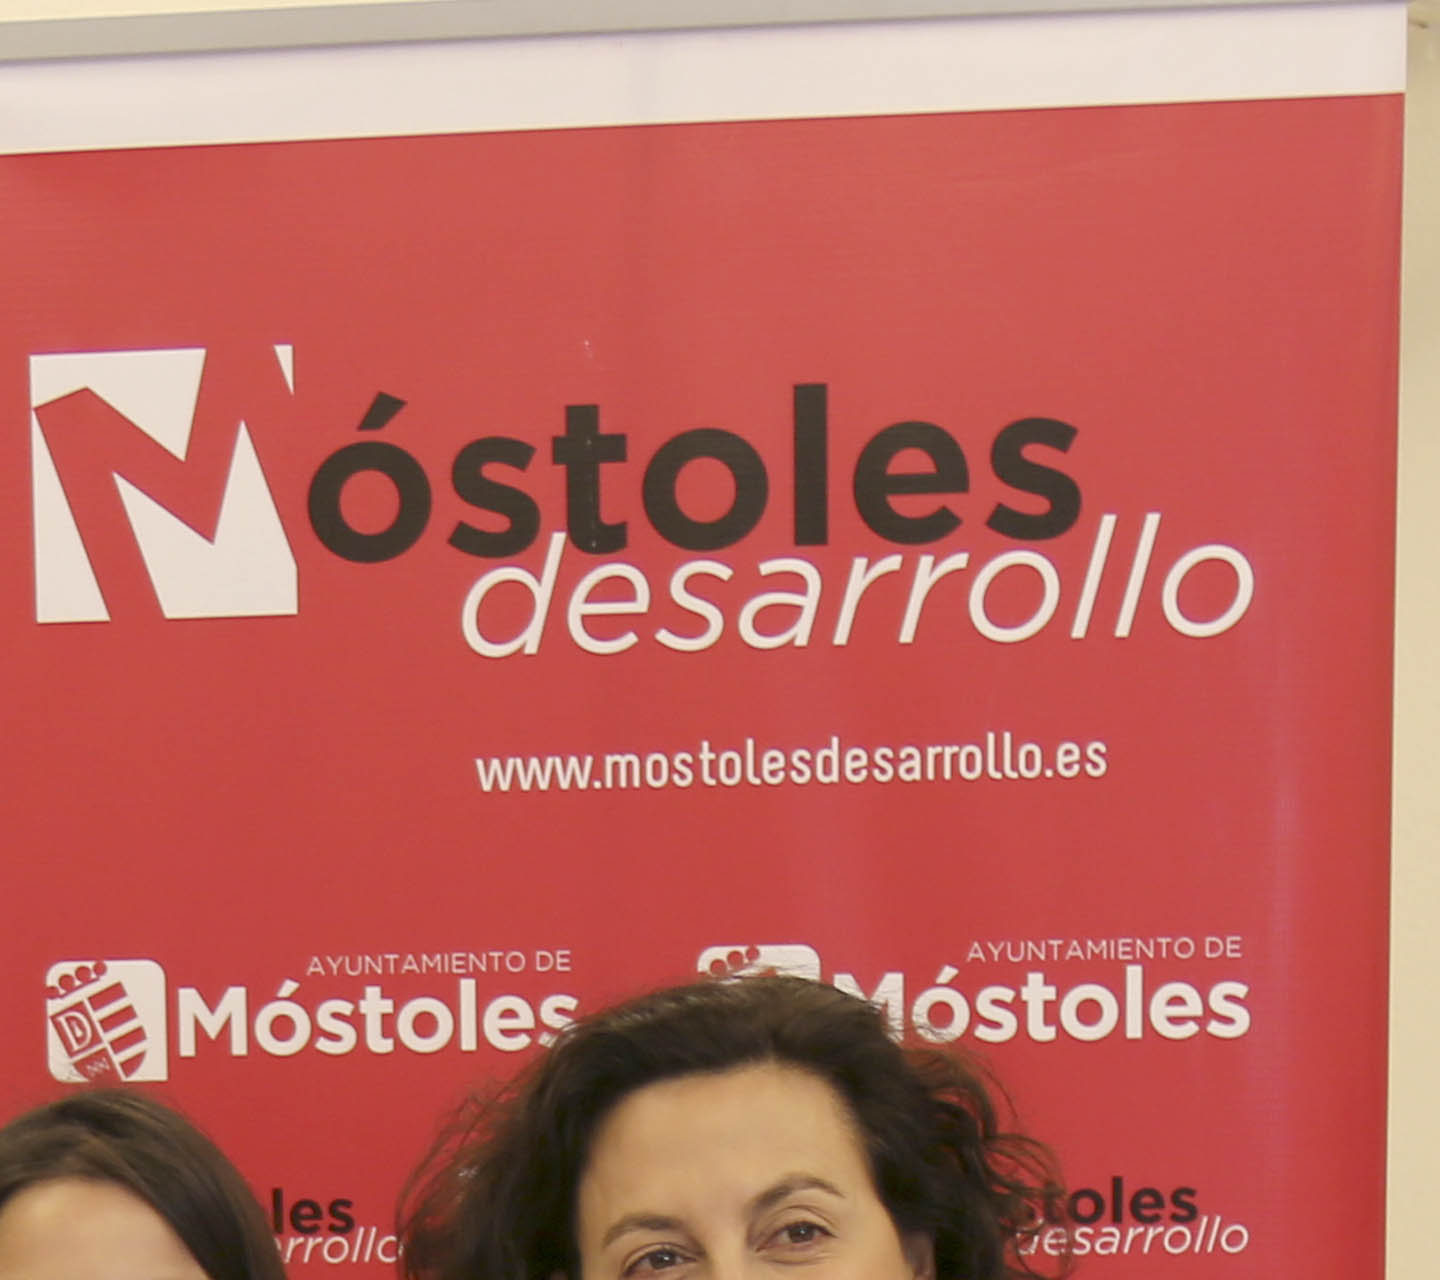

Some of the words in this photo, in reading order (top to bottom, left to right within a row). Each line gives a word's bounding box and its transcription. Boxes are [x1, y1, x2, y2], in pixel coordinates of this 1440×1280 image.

[460, 511, 1255, 659] desarrollo
[474, 730, 1108, 793] www.mostolesdesarrollo.es
[306, 951, 526, 977] AYUNTAMIENTO
[534, 950, 573, 973] DE
[966, 937, 1196, 963] AYUNTAMIENTO
[1204, 936, 1242, 959] DE
[177, 978, 579, 1058] Móstoles
